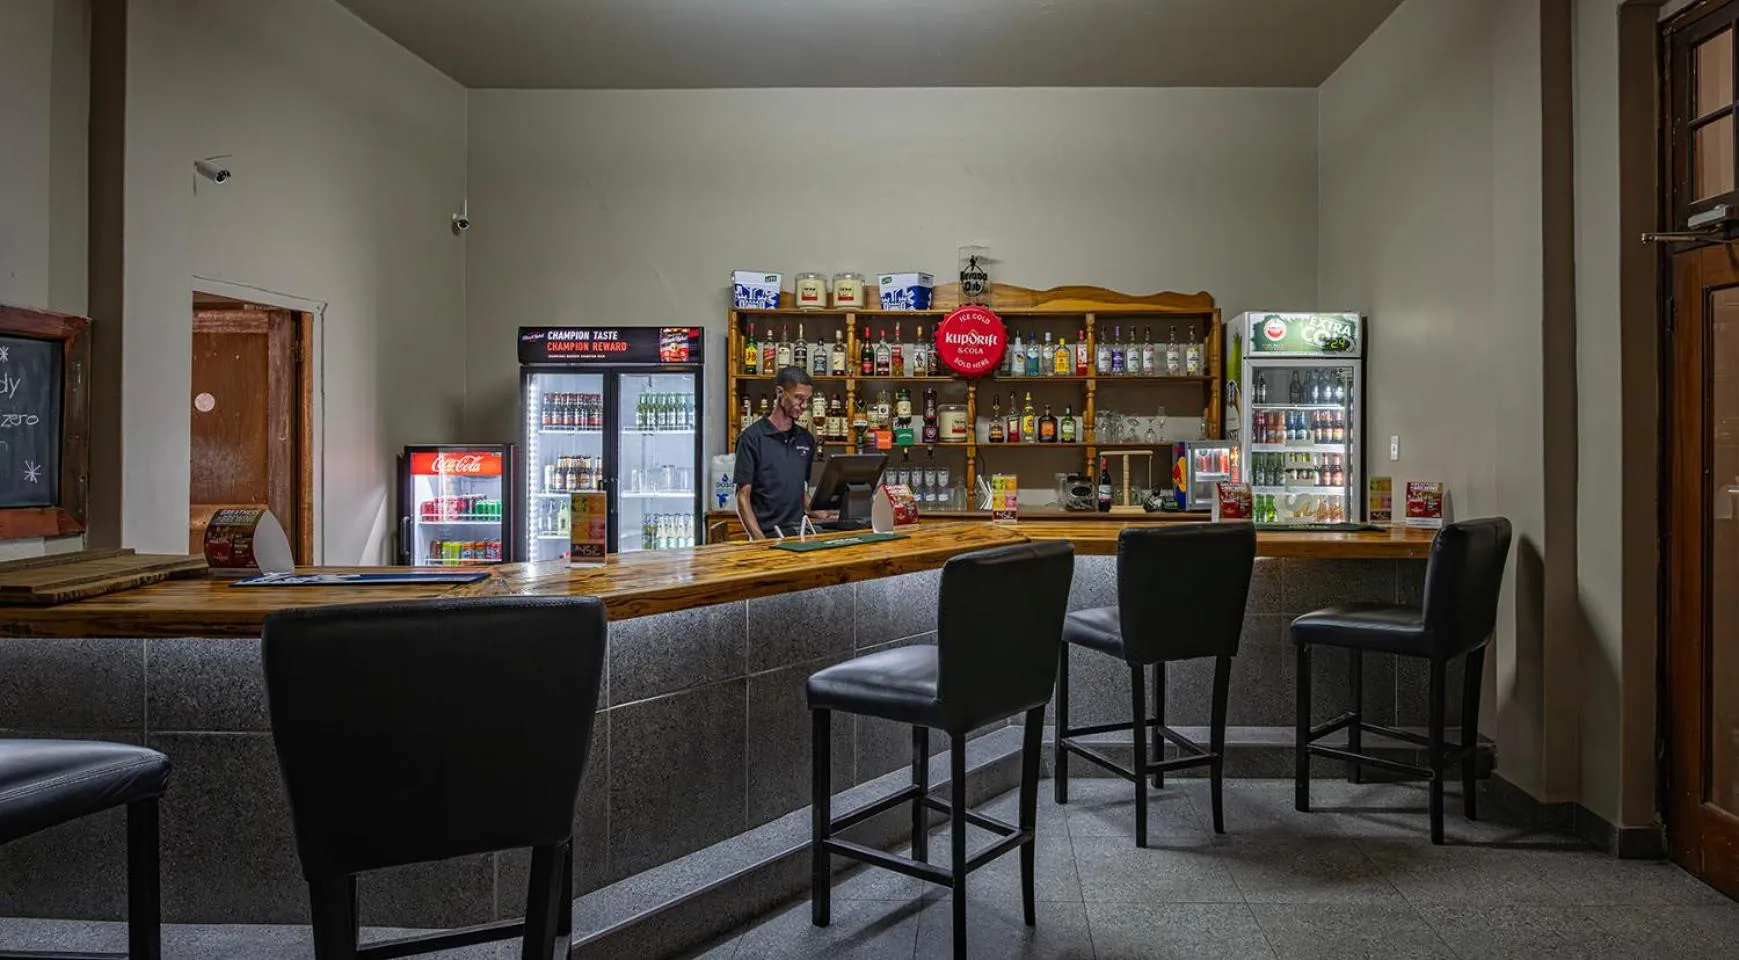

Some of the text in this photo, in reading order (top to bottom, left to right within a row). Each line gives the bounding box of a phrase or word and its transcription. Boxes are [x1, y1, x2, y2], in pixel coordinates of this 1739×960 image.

[959, 313, 991, 325] ICE COLD
[1309, 316, 1352, 337] EXTRA
[547, 330, 618, 340] CHAMPION TASTE
[547, 341, 627, 351] CHAMPION REWARD
[965, 347, 984, 355] COLA
[954, 357, 990, 369] SOLD HERE
[1, 414, 40, 427] zero
[431, 455, 484, 473] Coca-Cola
